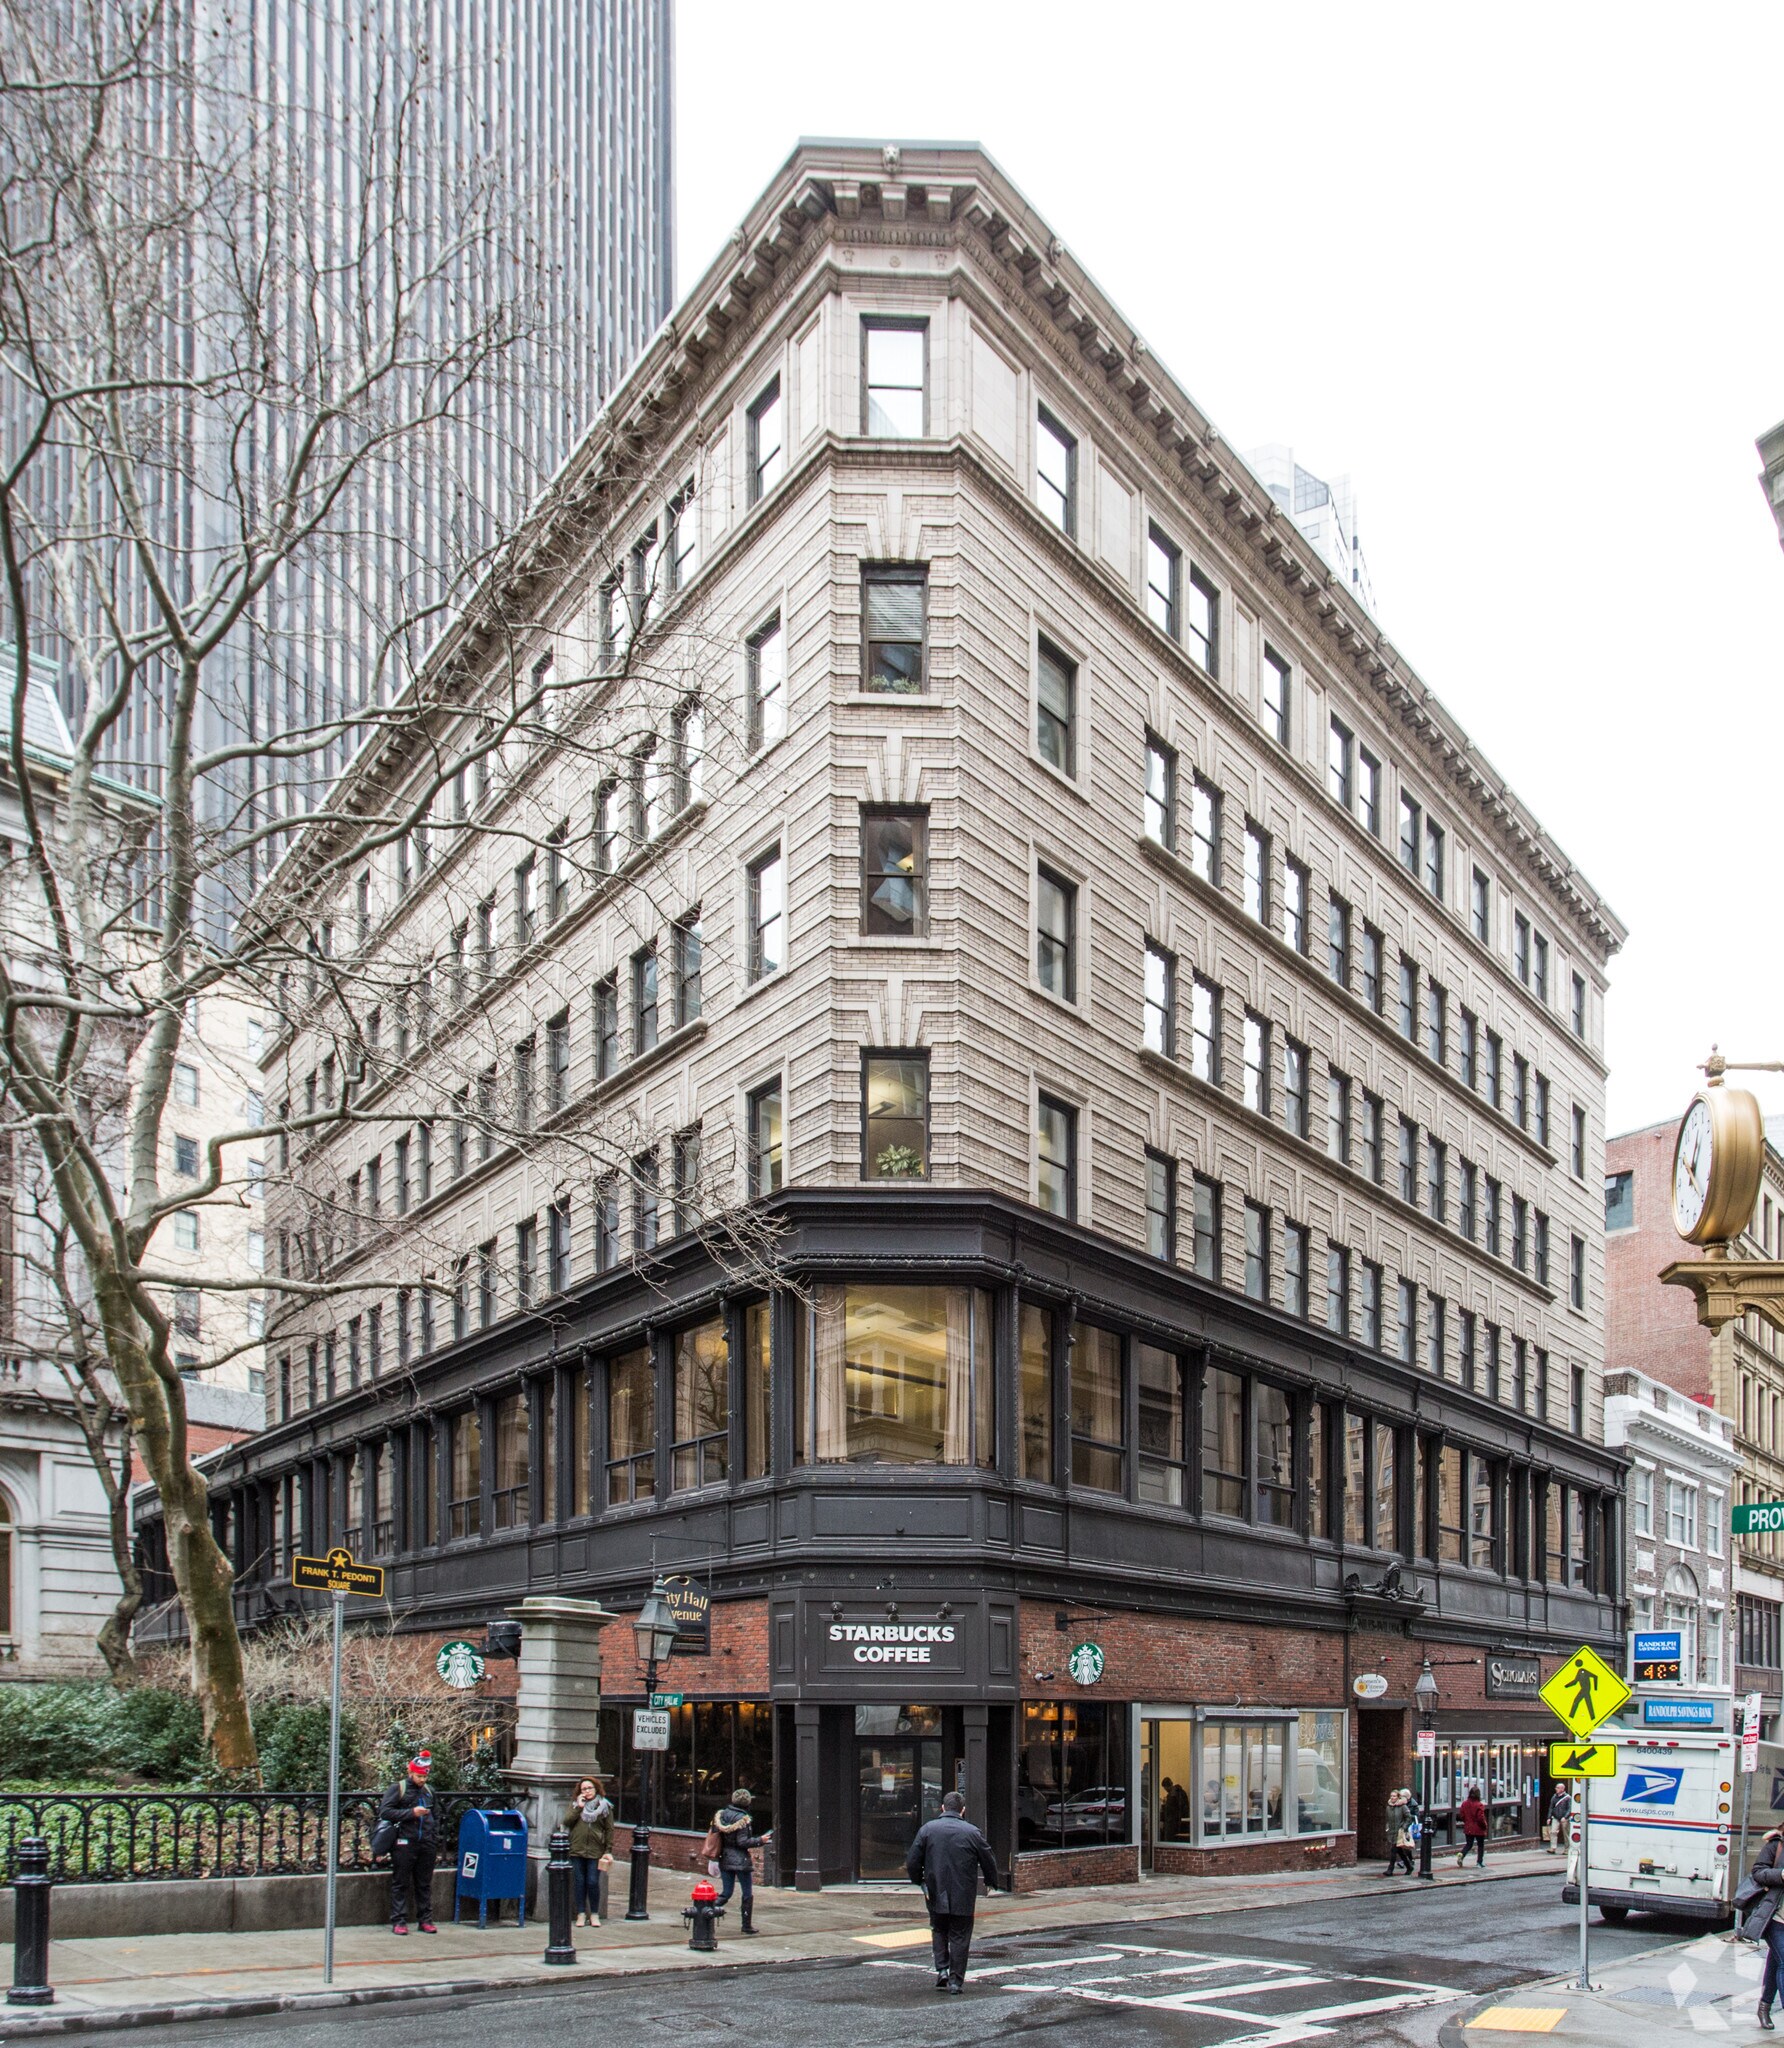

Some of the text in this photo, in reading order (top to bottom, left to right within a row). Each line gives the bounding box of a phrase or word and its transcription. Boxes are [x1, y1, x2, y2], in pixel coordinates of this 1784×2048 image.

[1749, 1507, 1784, 1530] PRO
[302, 1566, 375, 1583] FRANK T. PEDONTI
[327, 1579, 351, 1590] SQUARE
[666, 1591, 708, 1610] ity Hall
[671, 1609, 703, 1621] venue
[829, 1625, 955, 1642] STARBUCKS
[853, 1646, 931, 1663] COFFEE
[653, 1695, 664, 1706] CITY
[1648, 1705, 1677, 1717] RANDOLPH
[1678, 1706, 1699, 1718] SAVINGS
[1699, 1707, 1712, 1718] BANK
[637, 1715, 667, 1724] VEHICLES
[636, 1725, 667, 1735] EXCLUDED
[1636, 1747, 1673, 1755] 6400439
[1620, 1807, 1675, 1816] www.usps.com
